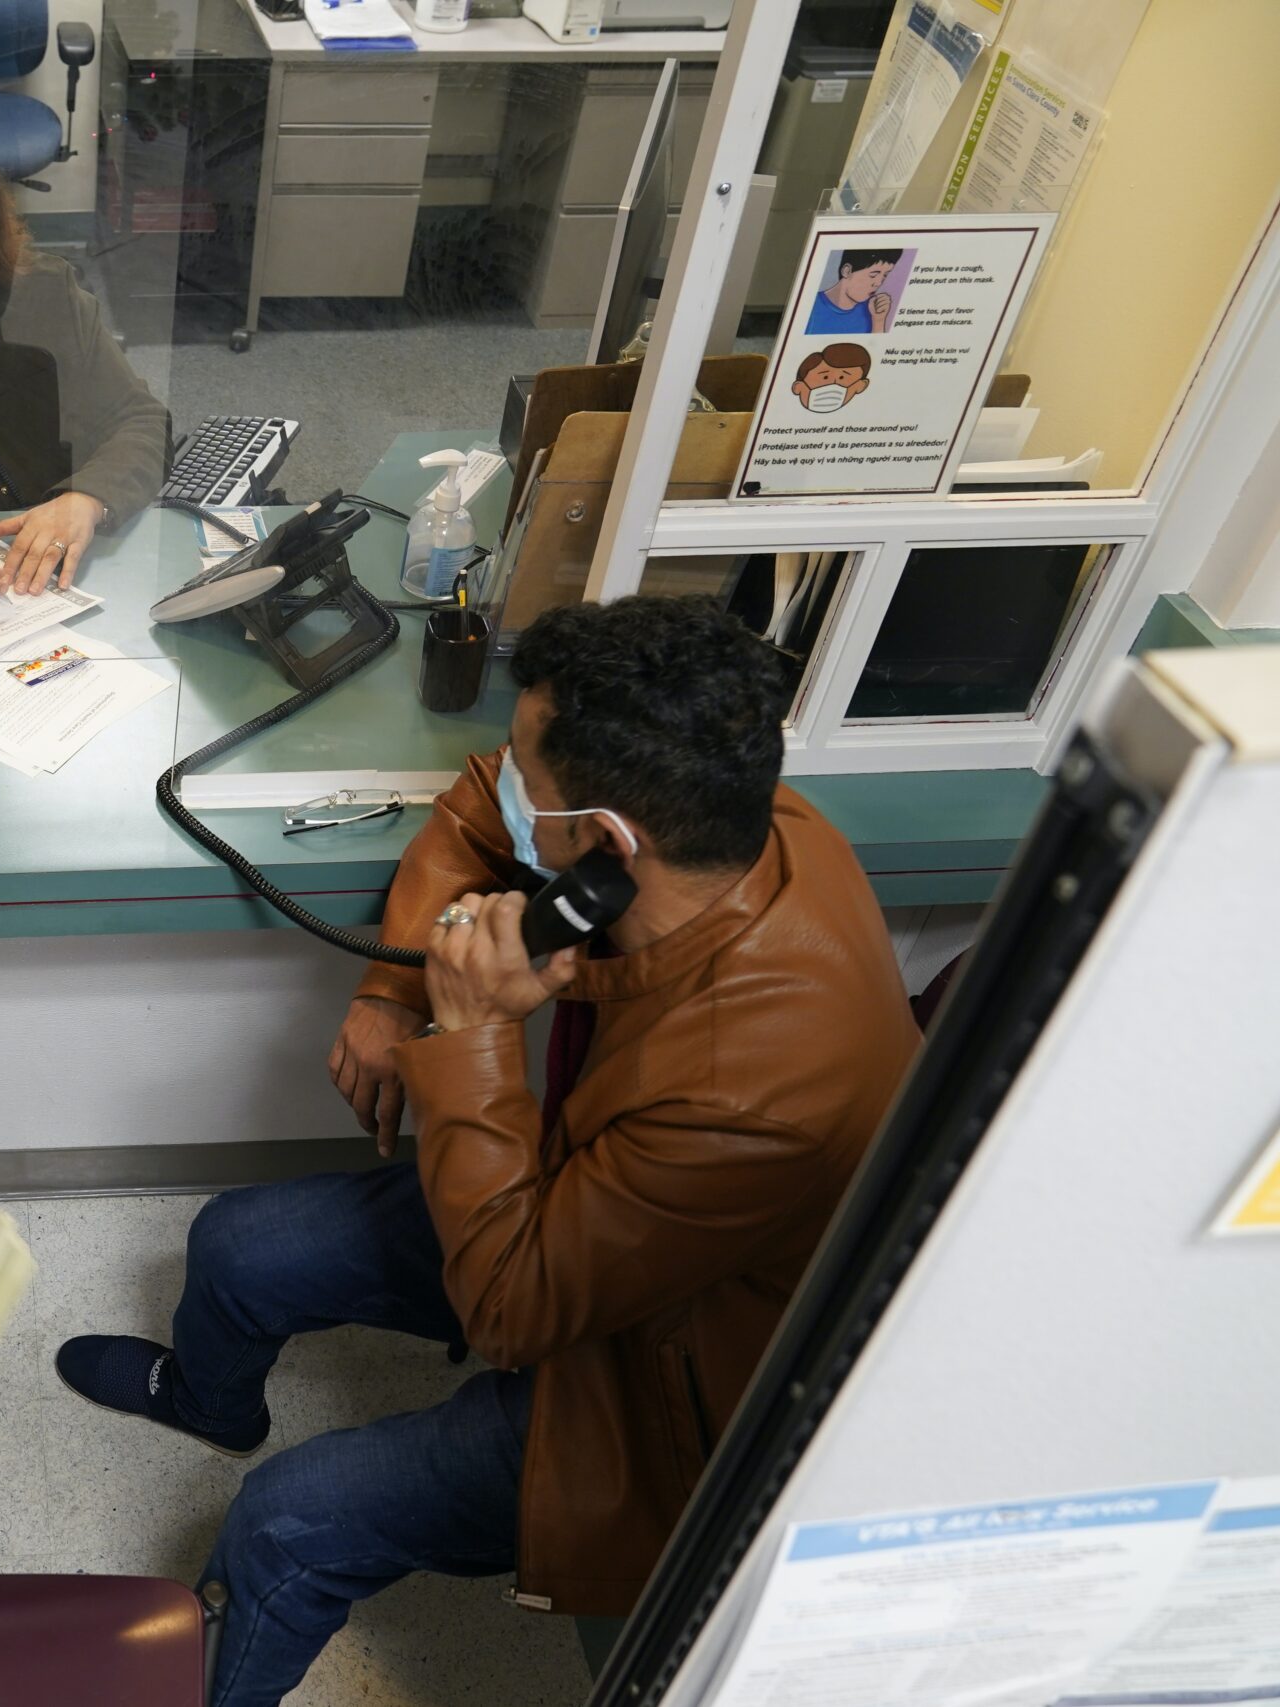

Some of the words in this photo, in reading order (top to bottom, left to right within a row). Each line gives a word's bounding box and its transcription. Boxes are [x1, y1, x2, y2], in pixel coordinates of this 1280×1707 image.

[942, 154, 969, 211] ZATION
[969, 66, 1003, 142] SERVICES
[960, 264, 984, 273] cough,
[909, 277, 932, 285] please
[926, 308, 939, 316] tos,
[940, 308, 953, 316] por
[955, 306, 974, 314] favor
[958, 346, 971, 354] vui
[898, 358, 918, 366] mang
[763, 427, 793, 435] Protect
[794, 425, 827, 436] yourself
[828, 425, 844, 434] and
[845, 425, 868, 433] those
[869, 424, 898, 433] around
[899, 424, 919, 433] you!
[800, 442, 823, 450] usted
[849, 440, 886, 450] personas
[905, 438, 949, 448] alrededor!
[893, 454, 913, 464] xung
[914, 453, 943, 463] quanh!
